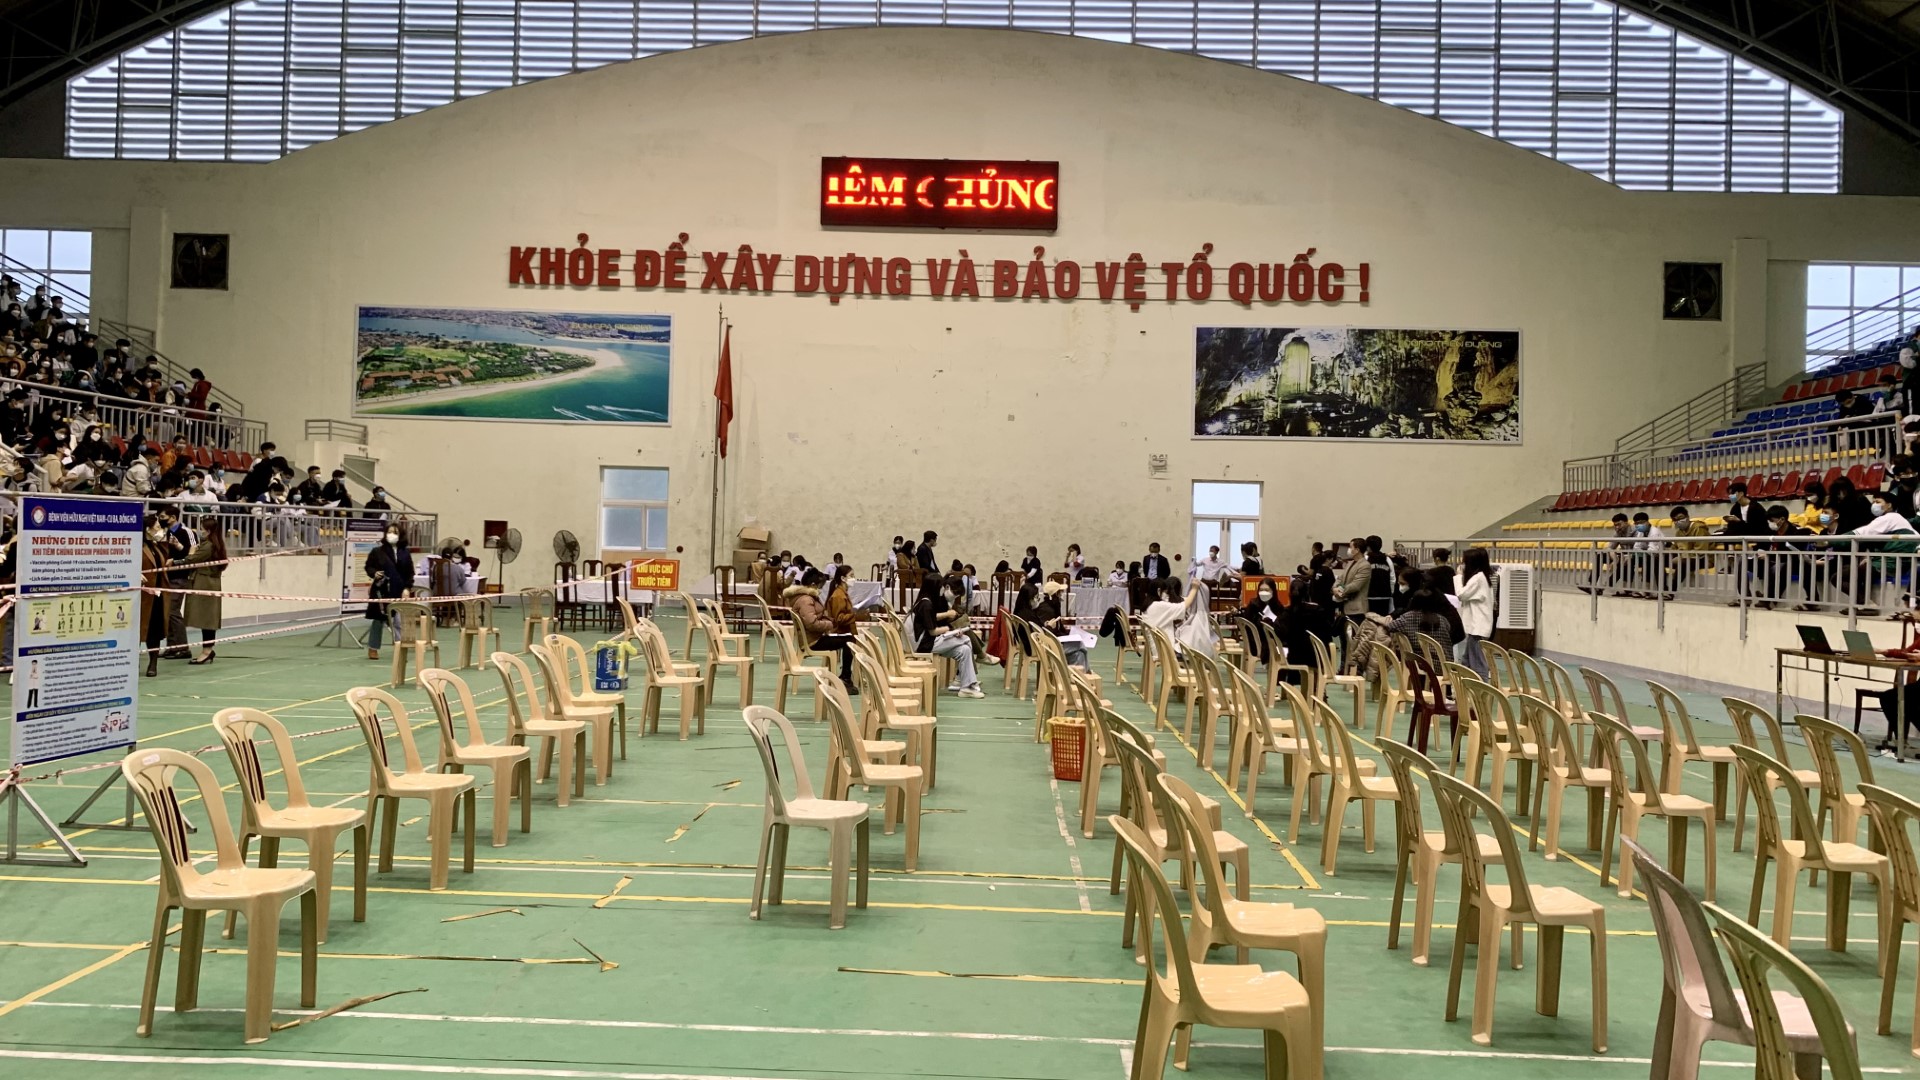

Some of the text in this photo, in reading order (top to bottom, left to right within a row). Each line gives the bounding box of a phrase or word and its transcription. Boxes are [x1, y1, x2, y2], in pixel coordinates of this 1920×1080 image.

[509, 233, 621, 287] KHỎE
[633, 232, 689, 289] ĐỂ
[700, 244, 782, 292] XÂY
[795, 253, 911, 304] DỰNG
[926, 249, 980, 298] VÀ
[993, 246, 1080, 300] BẢO
[1095, 253, 1147, 310] VỆ
[1161, 243, 1213, 301] TỔ
[111, 535, 132, 546] BIẾT
[636, 564, 649, 574] KHU
[657, 575, 671, 587] TIÊM
